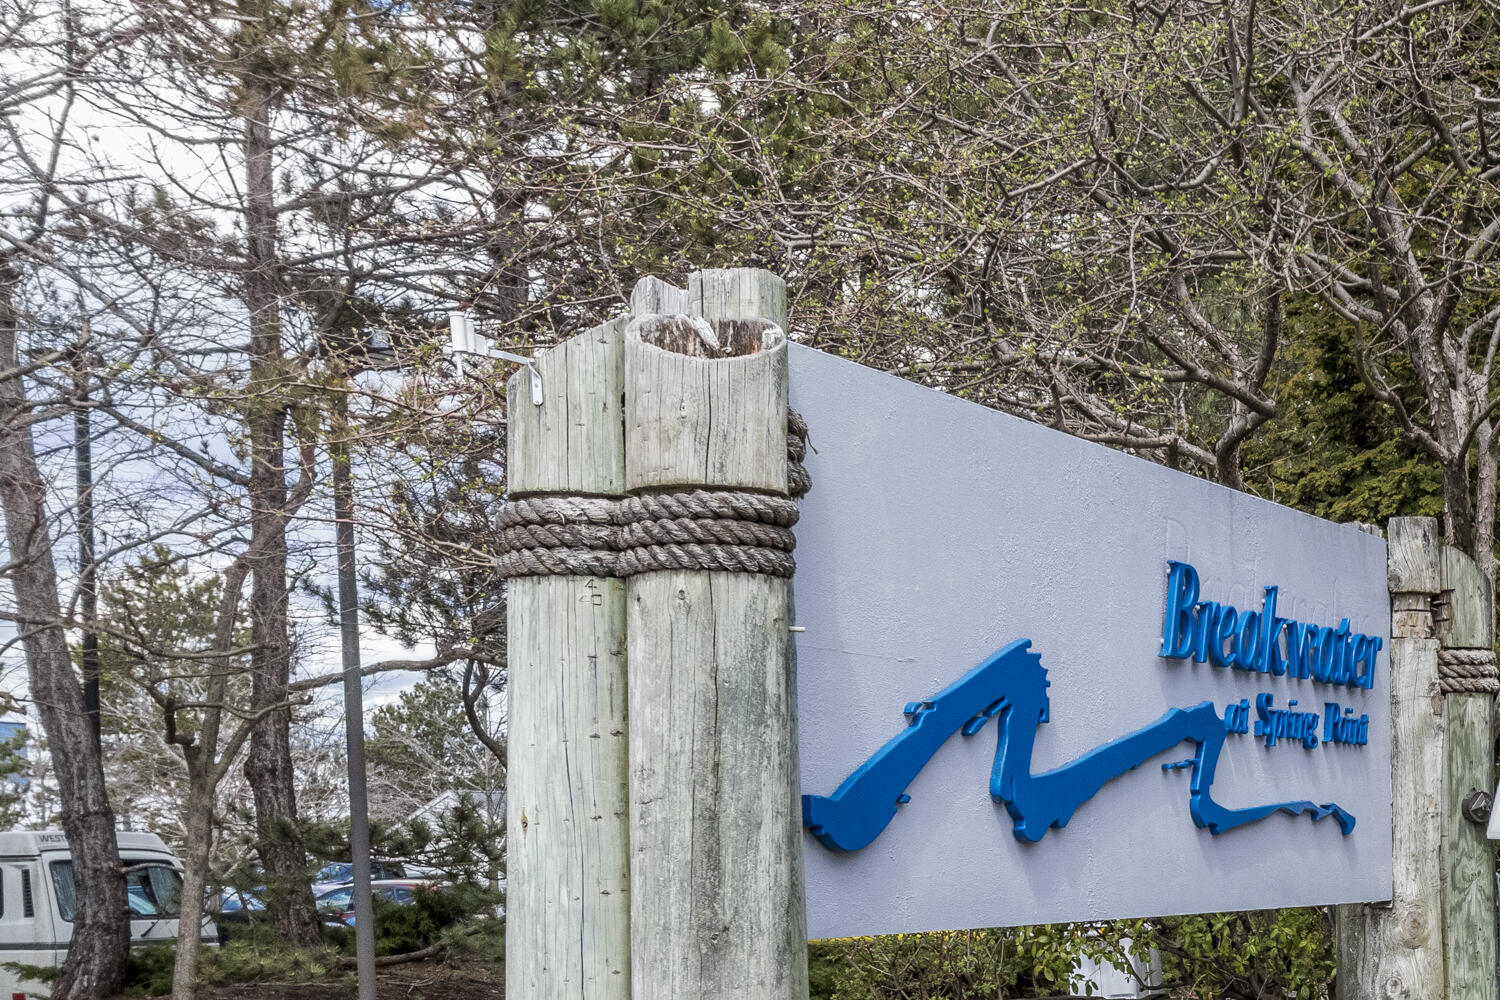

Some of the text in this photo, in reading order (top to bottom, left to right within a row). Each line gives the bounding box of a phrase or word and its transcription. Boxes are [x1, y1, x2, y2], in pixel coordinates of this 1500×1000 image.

[1158, 560, 1383, 690] Breakwater
[1224, 692, 1370, 749] at Spring Point
